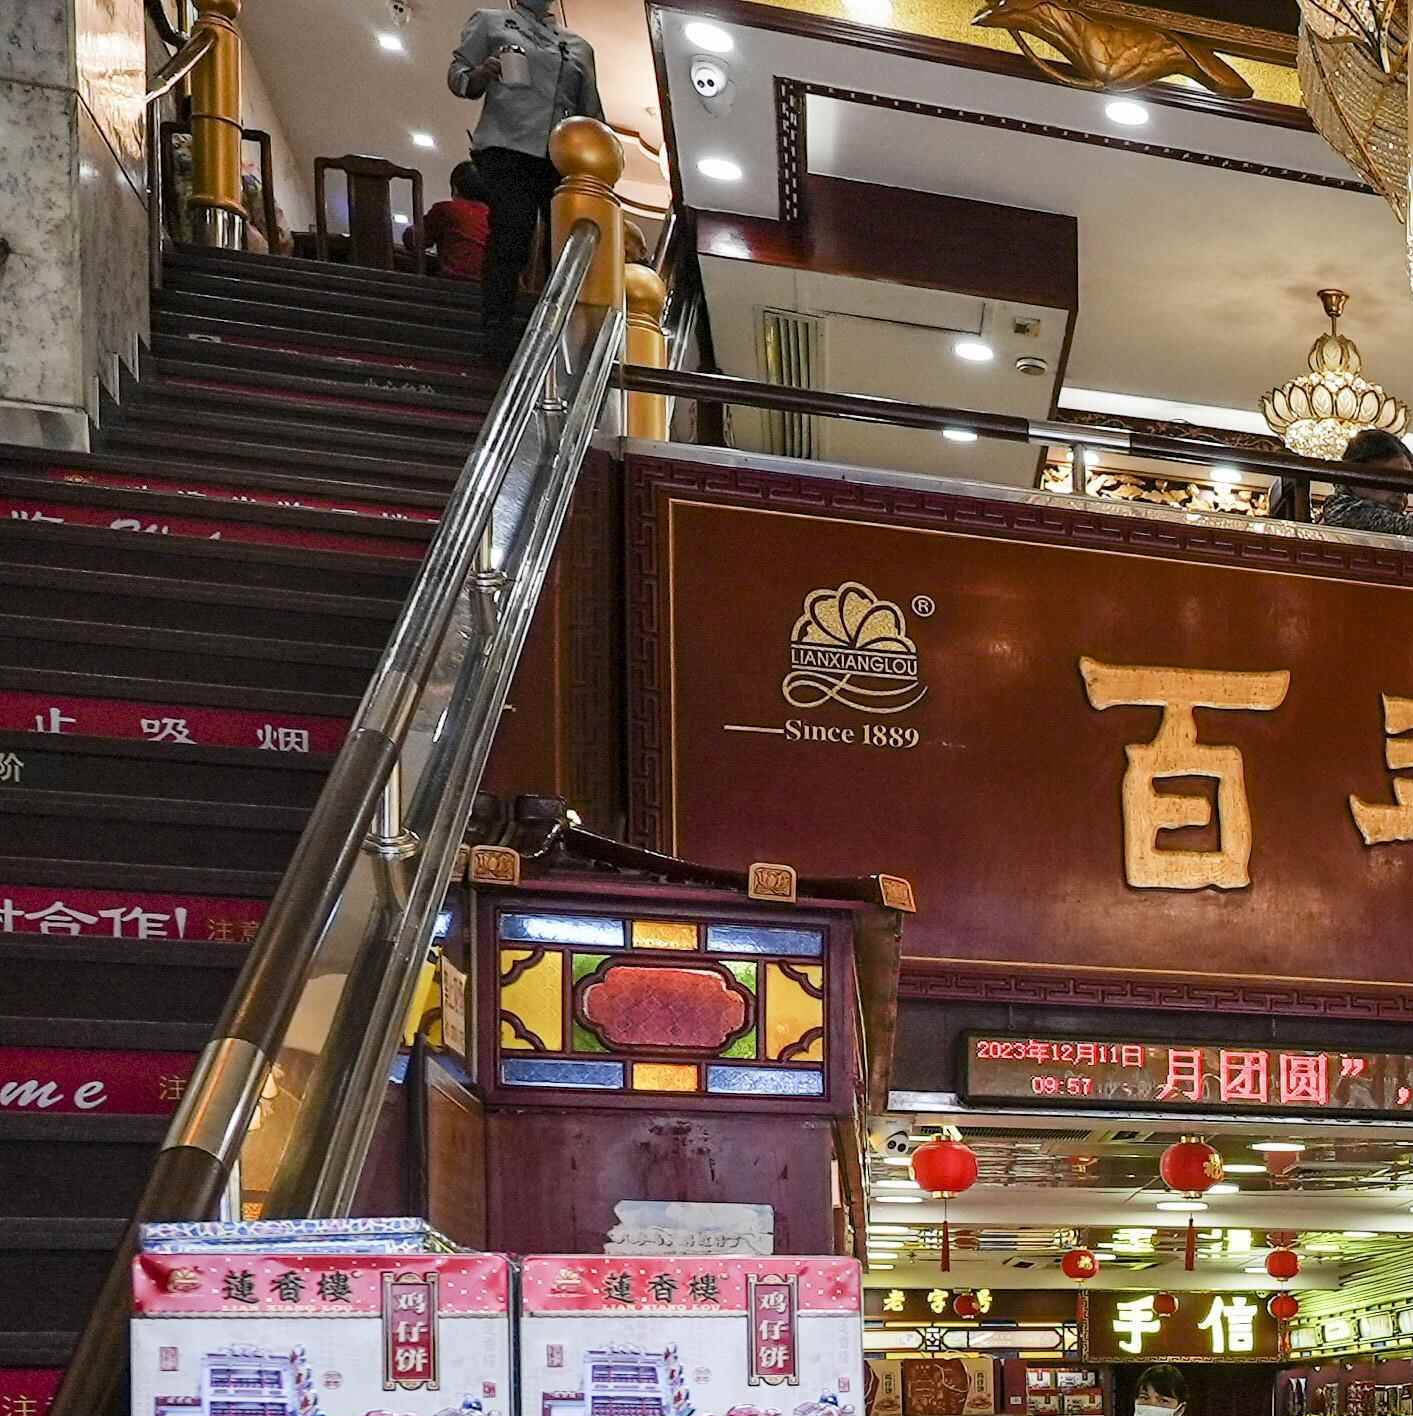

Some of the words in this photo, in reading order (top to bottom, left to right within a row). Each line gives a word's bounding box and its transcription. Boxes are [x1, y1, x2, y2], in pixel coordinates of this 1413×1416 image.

[790, 647, 919, 678] LIANXIANGLOU
[784, 718, 855, 747] Since
[861, 723, 920, 750] 1889
[976, 1038, 1145, 1068] 2023年12月11日
[1030, 1076, 1093, 1097] 09:57
[759, 1290, 790, 1370] 鸡仔饼
[1112, 1294, 1258, 1354] 手信
